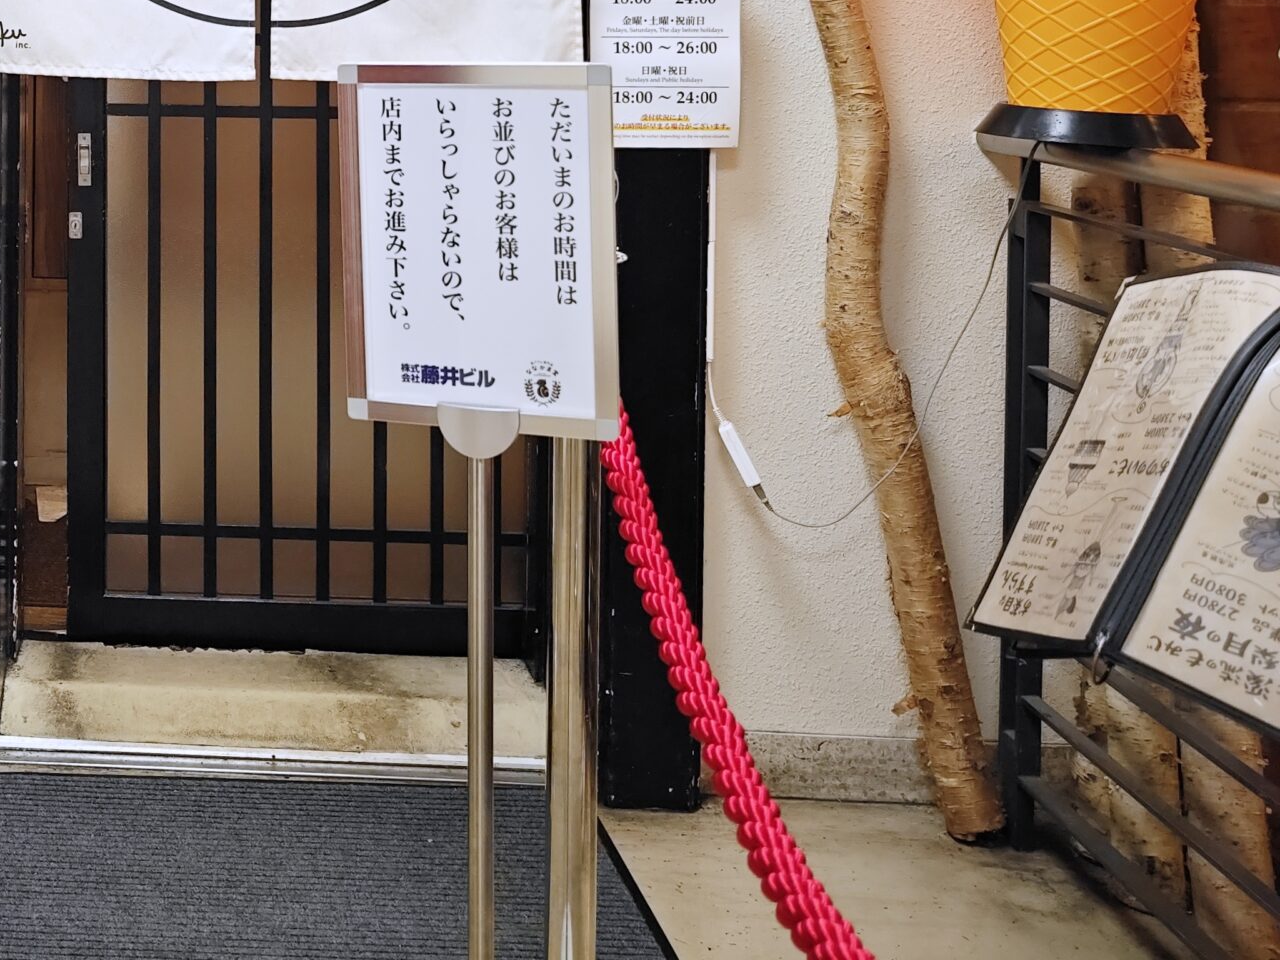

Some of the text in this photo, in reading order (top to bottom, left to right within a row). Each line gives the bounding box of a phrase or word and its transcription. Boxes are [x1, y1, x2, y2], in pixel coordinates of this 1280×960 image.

[622, 15, 705, 26] 金曜・土曜・祝前日
[613, 41, 718, 54] 18:00 26:00
[641, 66, 688, 76] 日曜・祝日
[613, 91, 718, 104] 18:00 24:00
[491, 97, 519, 282] お並びのお客様は
[549, 97, 578, 306] ただいまのお時間は
[380, 96, 411, 331] 店内までお進み下さい。
[435, 97, 466, 321] いらっしゃらないので、
[420, 364, 496, 389] 藤井ビル
[1181, 588, 1240, 622] 2780円
[1189, 572, 1247, 606] 3080円
